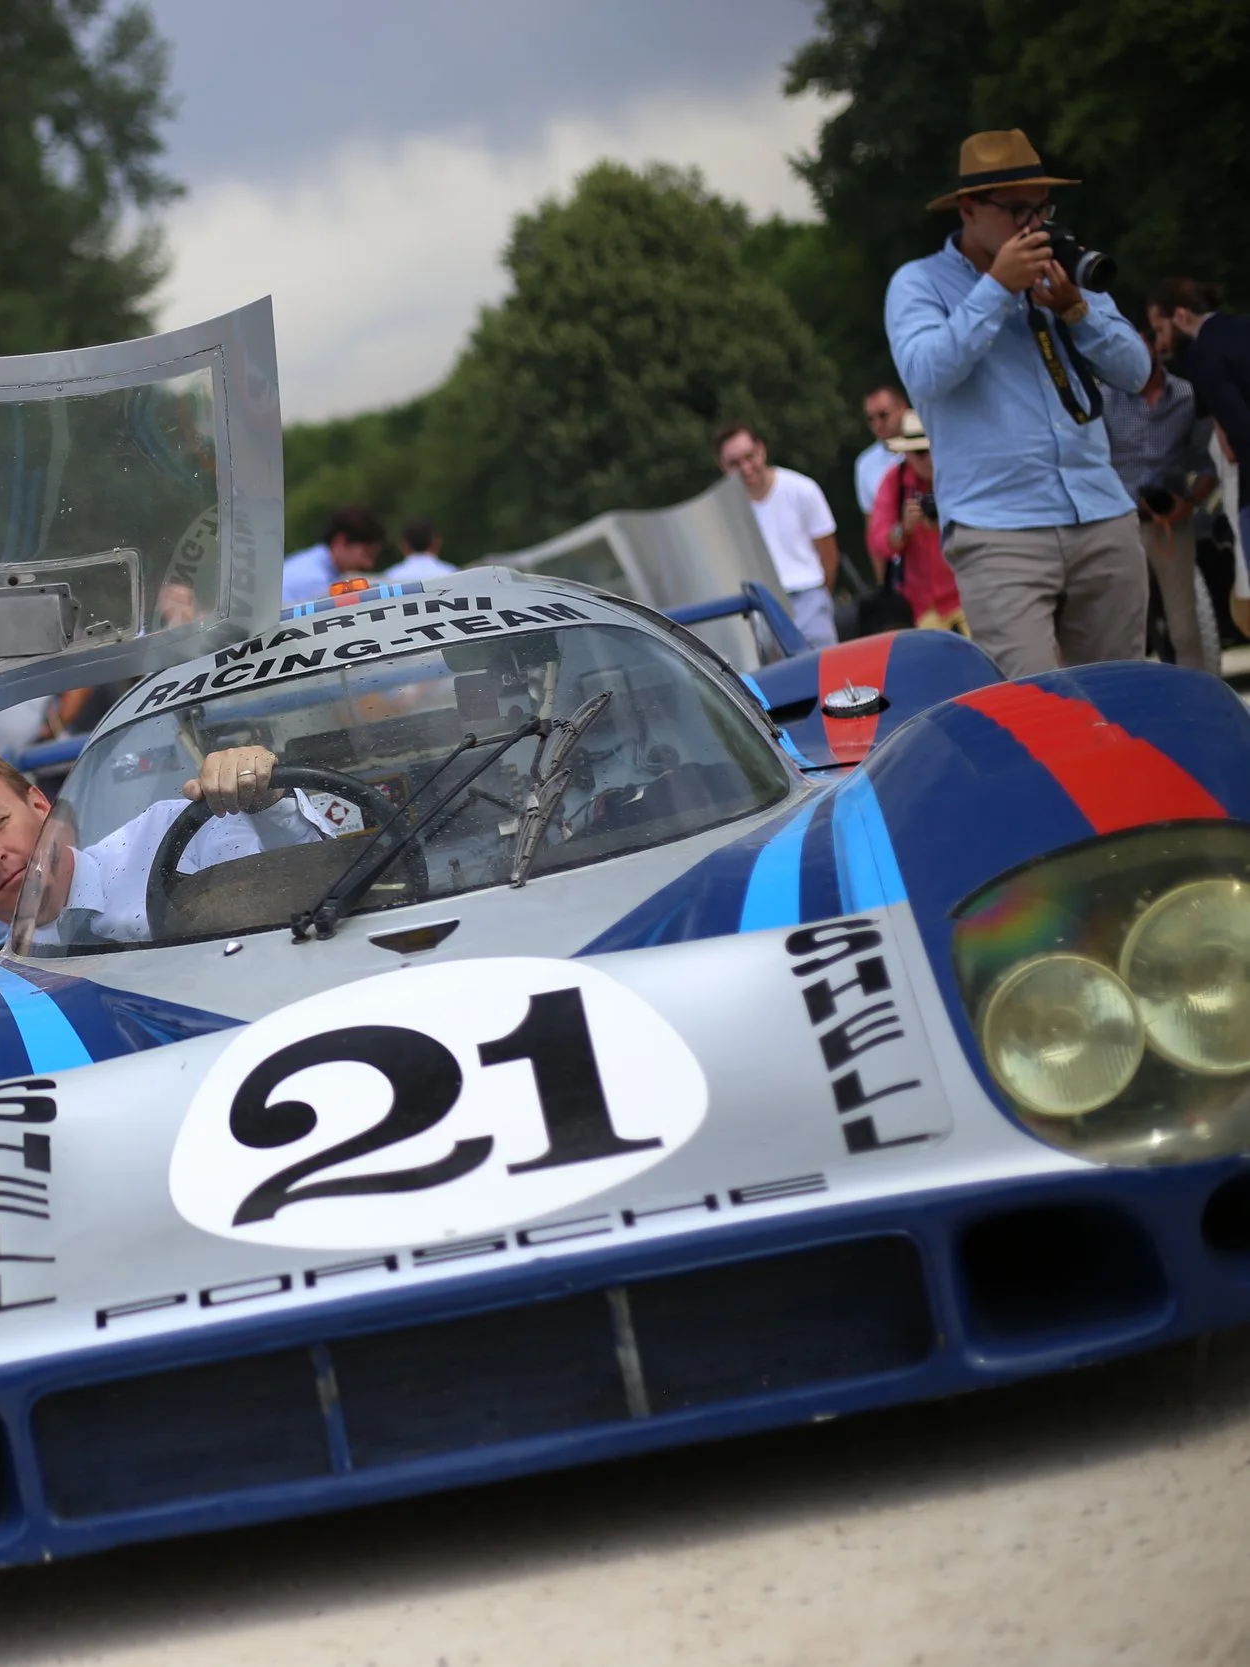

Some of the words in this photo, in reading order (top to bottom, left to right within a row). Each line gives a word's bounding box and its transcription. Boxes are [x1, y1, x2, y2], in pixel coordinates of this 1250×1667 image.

[135, 603, 592, 713] RACING-TEAM
[215, 597, 493, 668] MARTINI
[230, 986, 663, 1227] 21
[785, 918, 931, 1155] SHELL
[96, 1174, 829, 1329] PORSCHE
